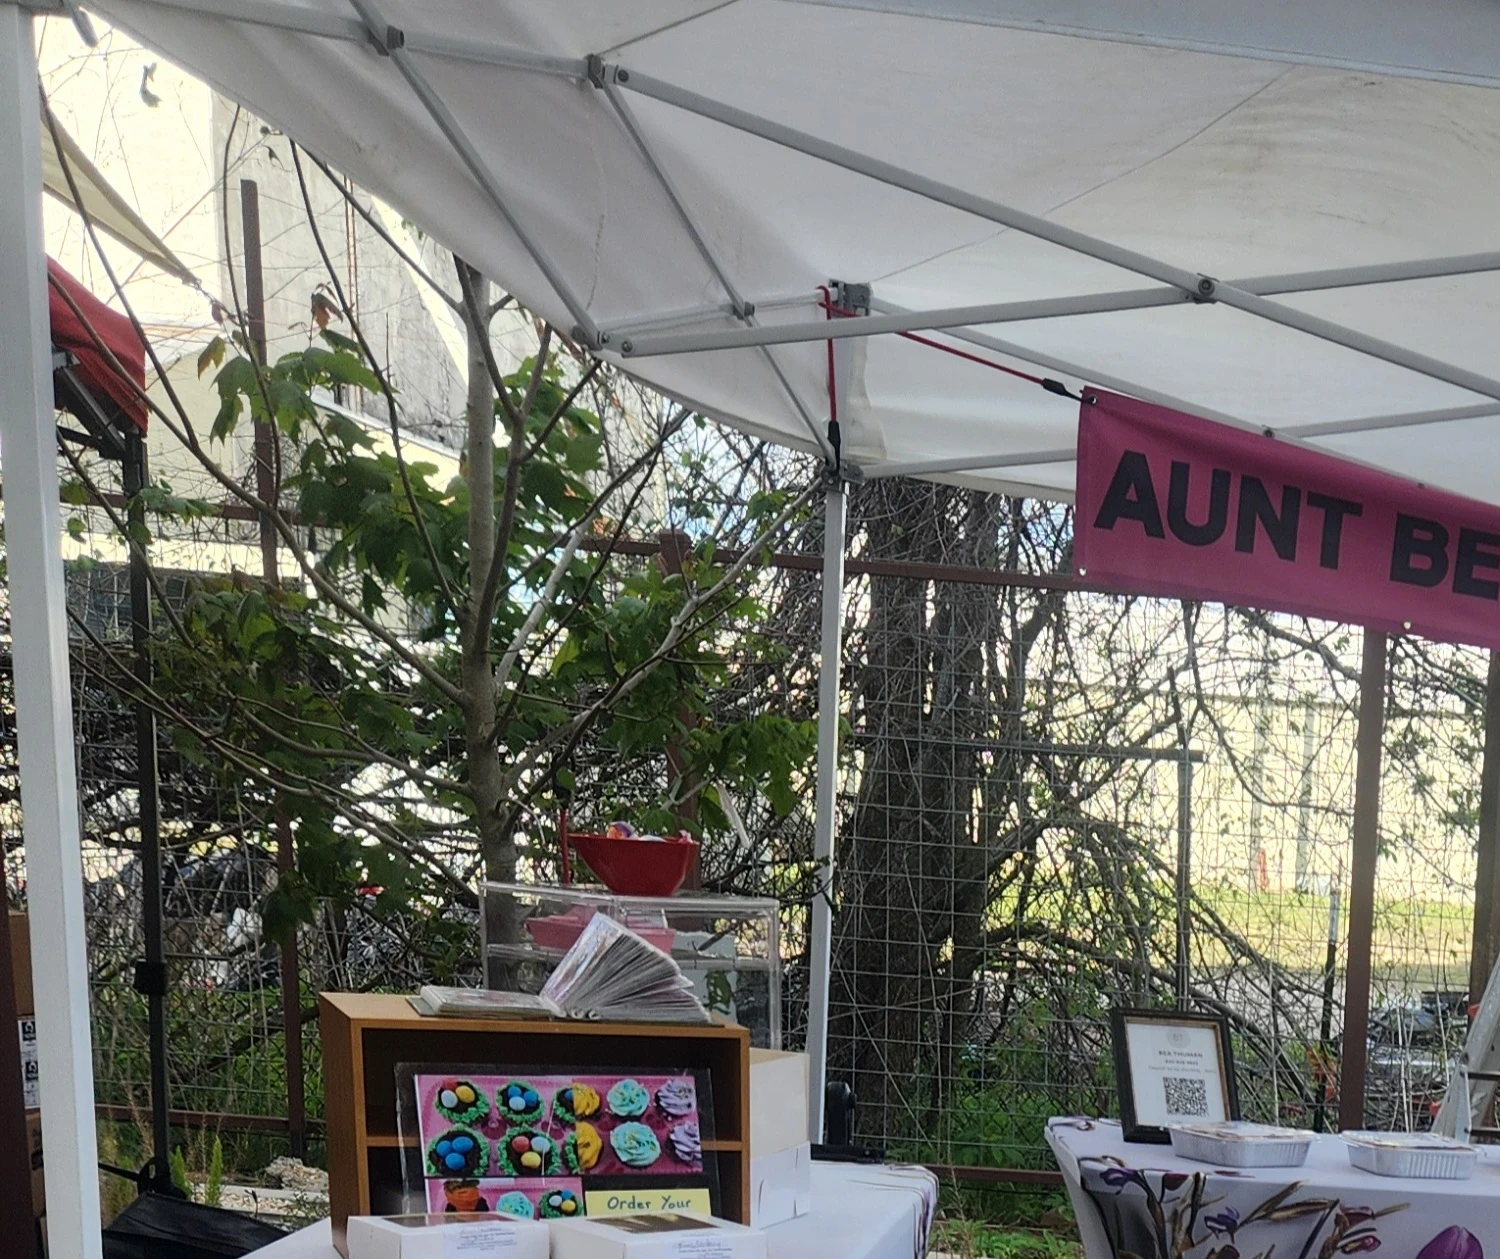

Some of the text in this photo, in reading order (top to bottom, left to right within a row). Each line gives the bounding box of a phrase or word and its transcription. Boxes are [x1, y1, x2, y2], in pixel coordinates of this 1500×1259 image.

[1093, 449, 1362, 570] AUNT
[607, 1195, 691, 1210] Order Your
